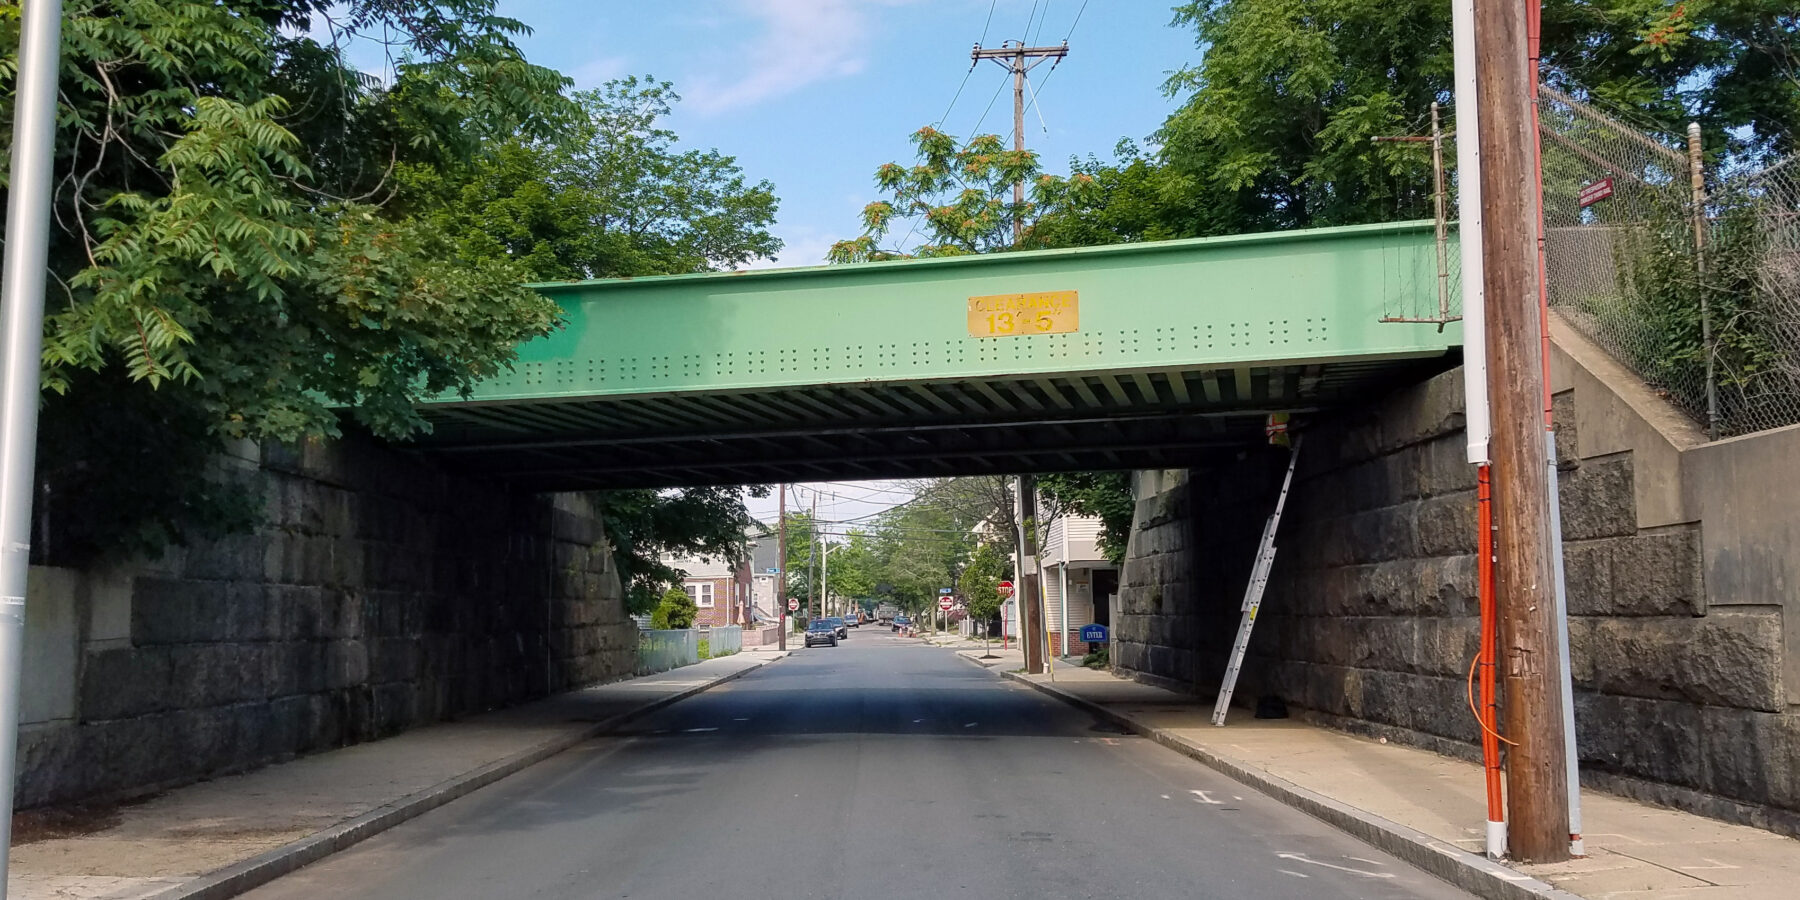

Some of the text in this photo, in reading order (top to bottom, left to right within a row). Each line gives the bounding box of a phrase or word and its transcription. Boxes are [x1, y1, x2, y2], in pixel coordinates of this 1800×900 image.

[975, 294, 1072, 312] CLEARANCE
[998, 586, 1013, 594] STOP
[1086, 631, 1103, 639] ENTER
